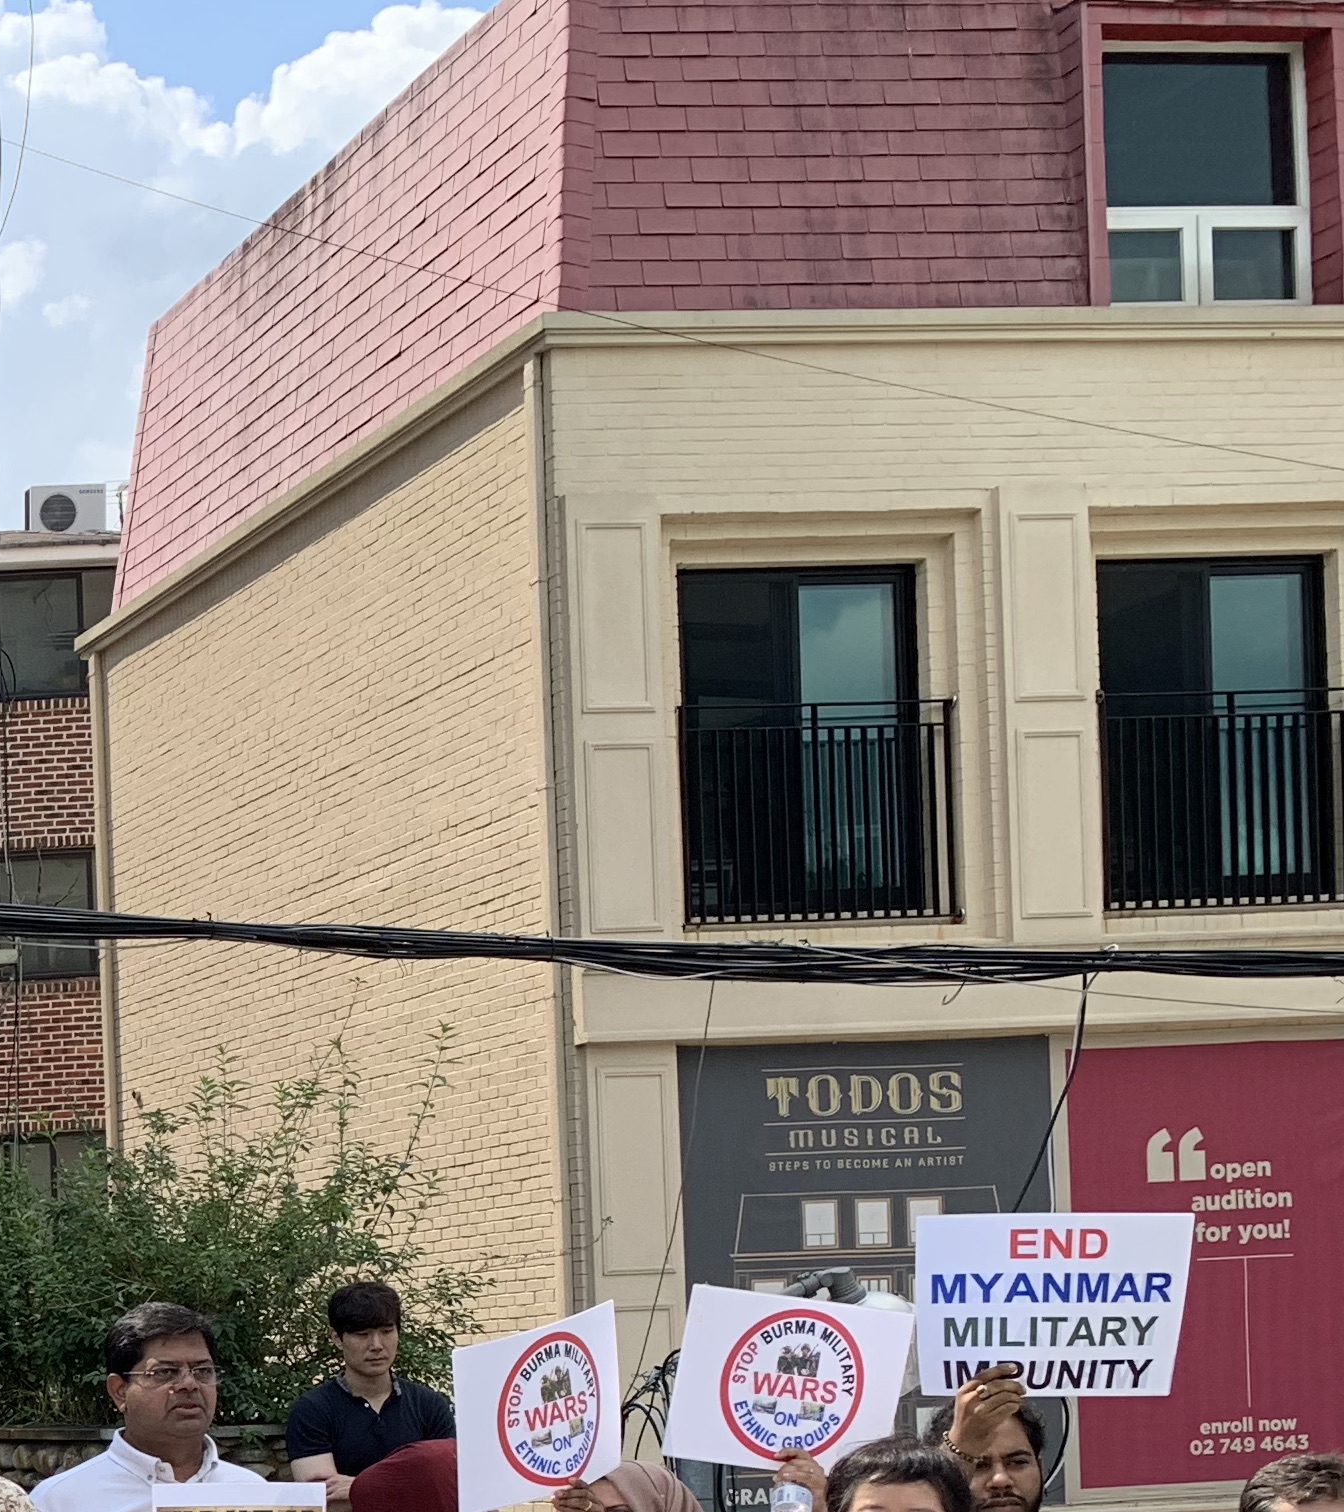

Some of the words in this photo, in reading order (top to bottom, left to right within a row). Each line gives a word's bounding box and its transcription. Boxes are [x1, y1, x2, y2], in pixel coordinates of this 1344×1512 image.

[766, 1070, 962, 1117] TODOS
[789, 1126, 942, 1148] MUSICAL
[769, 1160, 810, 1172] STEPS
[815, 1159, 831, 1170] TO
[837, 1157, 889, 1170] BECOME
[894, 1156, 912, 1168] AN
[918, 1154, 964, 1167] ARTIST
[1210, 1160, 1272, 1183] open
[1191, 1188, 1293, 1212] audition
[1009, 1228, 1109, 1260] END
[1195, 1222, 1232, 1242] for
[1238, 1219, 1291, 1244] you!
[931, 1272, 1172, 1304] MYANMAR
[943, 1316, 1160, 1347] MILITARY
[732, 1341, 758, 1384] STOP
[760, 1320, 816, 1345] BURMA
[820, 1327, 855, 1397] MILITARY
[507, 1384, 524, 1428] STOP
[520, 1343, 561, 1382] BURMA
[564, 1343, 596, 1398] MILITARY
[753, 1371, 838, 1404] WARS
[524, 1390, 588, 1432] WARS
[734, 1400, 777, 1447] ETHNIC
[782, 1413, 841, 1449] GROUPS
[774, 1411, 800, 1427] ON
[1199, 1416, 1254, 1435] enroll
[1258, 1418, 1297, 1432] now
[515, 1440, 561, 1475] ETHNIC
[565, 1420, 594, 1473] GROUPS
[552, 1435, 572, 1452] ON
[1189, 1439, 1215, 1455] 02
[1220, 1437, 1256, 1454] 749
[1260, 1434, 1310, 1452] 4643
[725, 1487, 773, 1507] GRA
